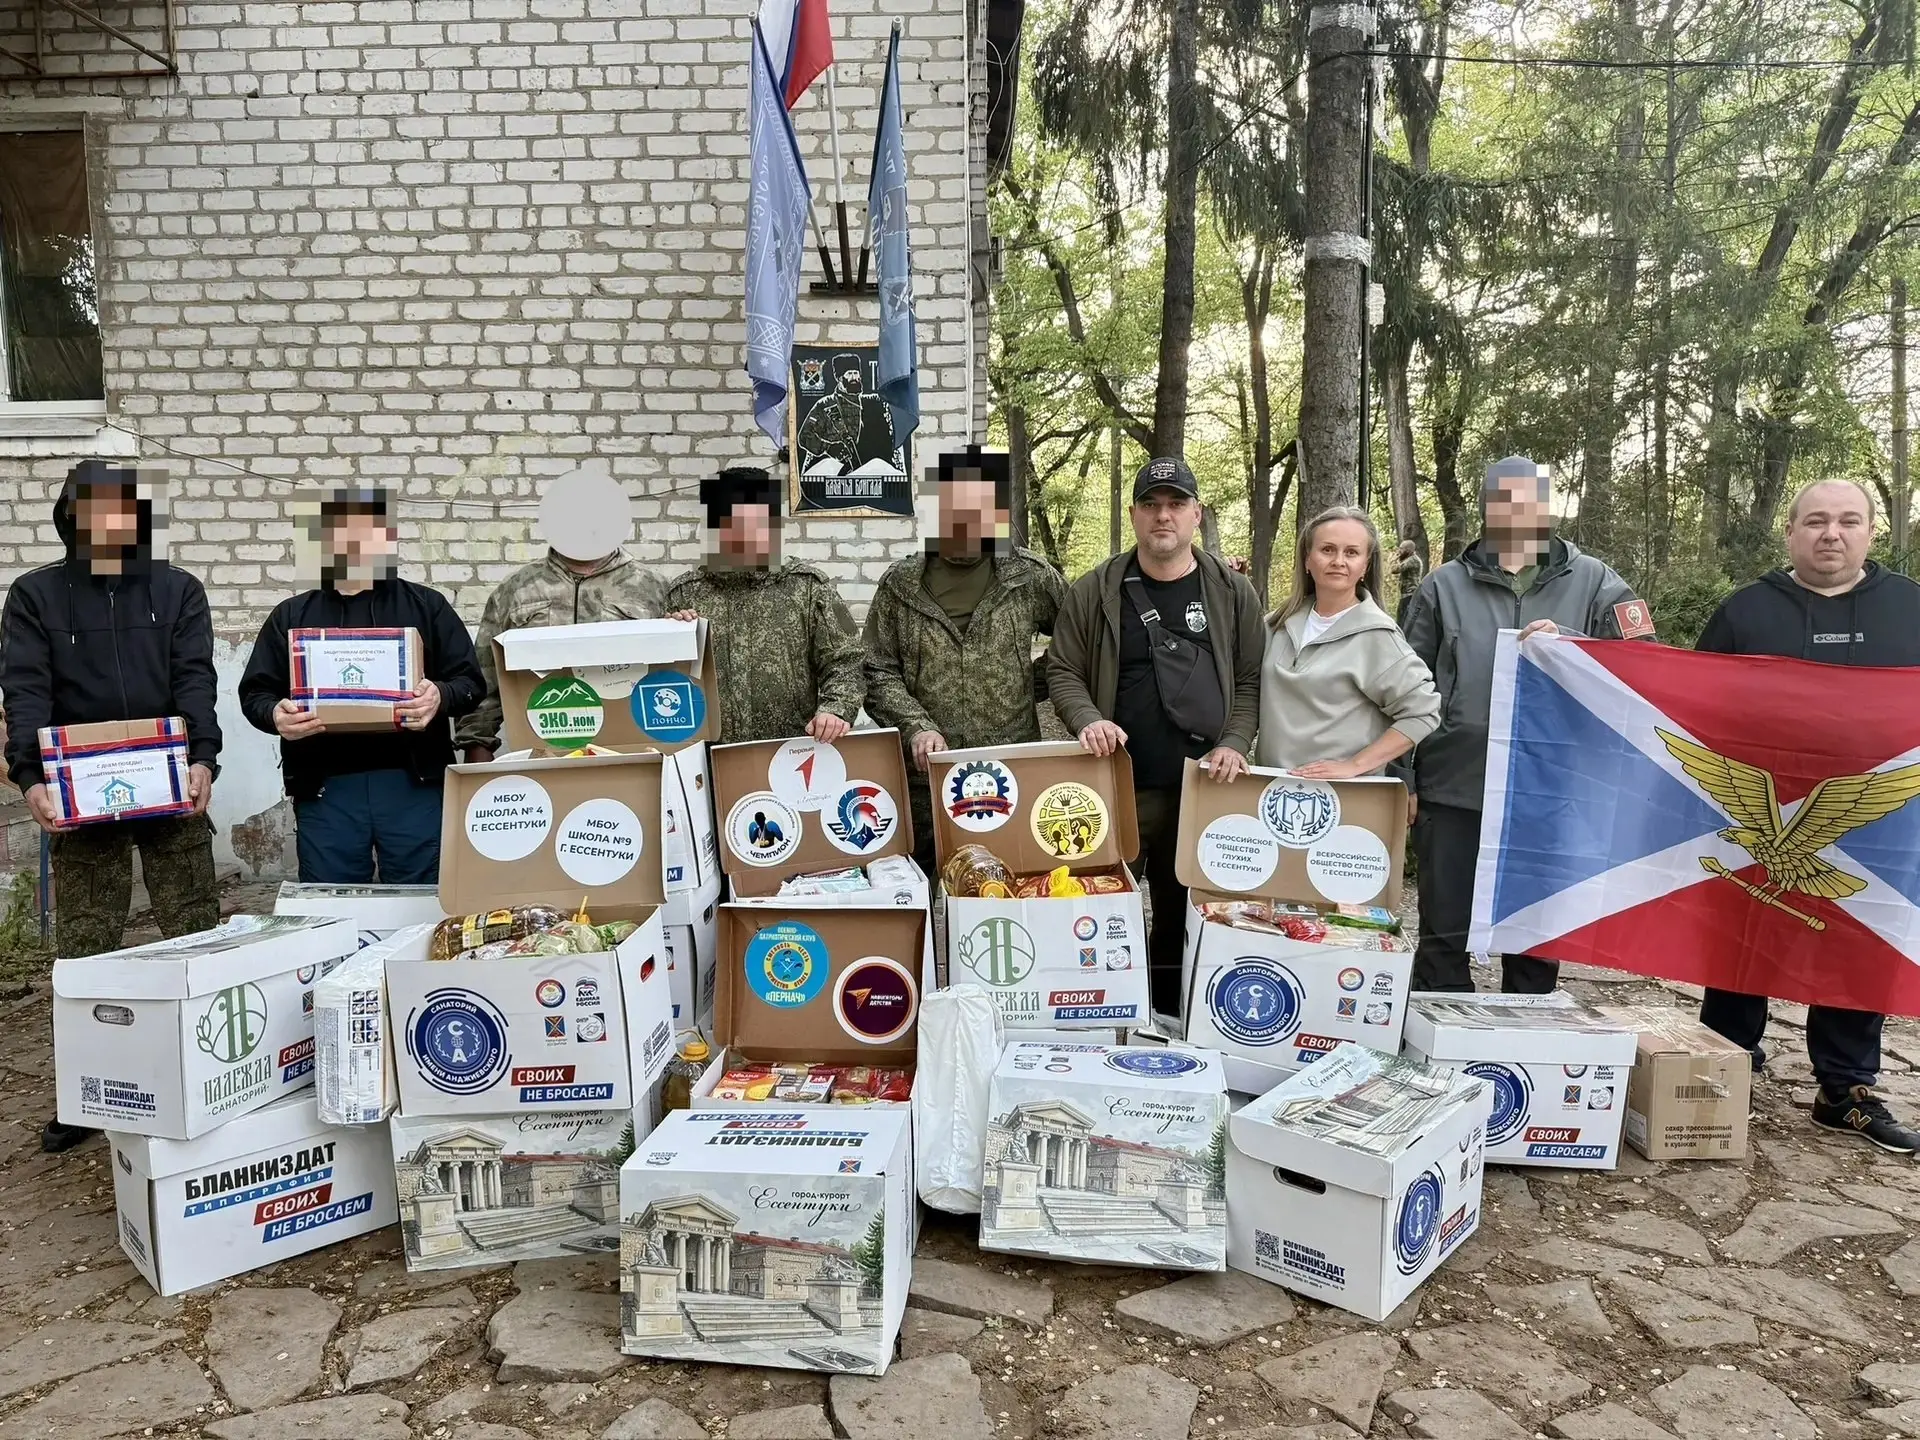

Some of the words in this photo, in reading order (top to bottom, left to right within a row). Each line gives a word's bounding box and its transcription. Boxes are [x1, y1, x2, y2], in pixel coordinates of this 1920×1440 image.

[788, 746, 815, 755] Первые
[493, 793, 527, 804] МБОУ
[475, 808, 518, 819] ШКОЛА
[536, 806, 543, 814] 4
[471, 824, 479, 833] Г.
[481, 819, 547, 832] ЕССЕНТУКИ
[586, 818, 620, 830] МБОУ
[567, 830, 610, 844] ШКОЛА
[612, 836, 632, 846] №9
[1205, 831, 1273, 847] ВСЕРОССИЙСКОЕ
[560, 843, 567, 853] Г.
[569, 844, 634, 861] ЕССЕНТУКИ
[750, 839, 791, 859] ЧЕМПИОН
[1215, 843, 1260, 855] ОБЩЕСТВО
[1221, 853, 1252, 863] ГЛУХИХ
[1316, 850, 1382, 863] ВСЕРОССИЙСКОЕ
[1216, 862, 1262, 873] ЕССЕНТУКИ
[1310, 859, 1353, 869] ОБЩЕСТВО
[1354, 863, 1387, 873] СЛЕПЫХ
[1329, 870, 1373, 879] ЕССЕНТУКИ
[1236, 967, 1282, 982] САНАТОРИЙ
[765, 991, 806, 1002] «ПЕРНАЧ»
[1054, 992, 1096, 1004] СВОИХ
[430, 1001, 477, 1014] САНАТОРИЙ
[1060, 1009, 1076, 1018] НЕ
[1078, 1007, 1132, 1018] БРОСАЕМ
[1217, 1005, 1236, 1031] ИМЕНИ
[1303, 1052, 1320, 1061] НЕ
[287, 1065, 300, 1078] НЕ
[421, 1053, 447, 1081] ИМЕНИ
[1467, 1065, 1511, 1079] САНАТОРИЙ
[203, 1054, 272, 1106] НАДЕЖДА
[517, 1069, 564, 1083] СВОИХ
[104, 1079, 139, 1091] ИЗГОТОВЛЕНО
[104, 1087, 155, 1104] БЛАНКИЗДАТ
[526, 1089, 543, 1100] НЕ
[546, 1087, 607, 1099] БРОСАЕМ
[1142, 1102, 1196, 1113] город-курорт
[1104, 1095, 1206, 1135] Ессентуки
[512, 1113, 614, 1141] Ессентуки
[1664, 1124, 1685, 1133] сахар
[1685, 1123, 1733, 1132] прессованный
[705, 1135, 864, 1147] БЛАНКИЗДАТ
[1529, 1129, 1570, 1141] СВОИХ
[1664, 1132, 1732, 1141] быстрорастворимый
[1670, 1141, 1697, 1149] кубиках
[1532, 1147, 1548, 1155] НЕ
[1550, 1147, 1601, 1157] БРОСАЕМ
[184, 1141, 337, 1201] БЛАНКИЗДАТ
[189, 1171, 325, 1215] ТИПОГРАФИЯ
[791, 1190, 851, 1201] город-курорт
[262, 1191, 319, 1219] СВОИХ
[748, 1185, 862, 1228] Ессентуки
[271, 1222, 292, 1238] НЕ
[295, 1197, 366, 1231] БРОСАЕМ
[1283, 1239, 1326, 1260] ИЗГОТОВЛЕНО
[1283, 1247, 1346, 1278] БЛАНКИЗДАТ
